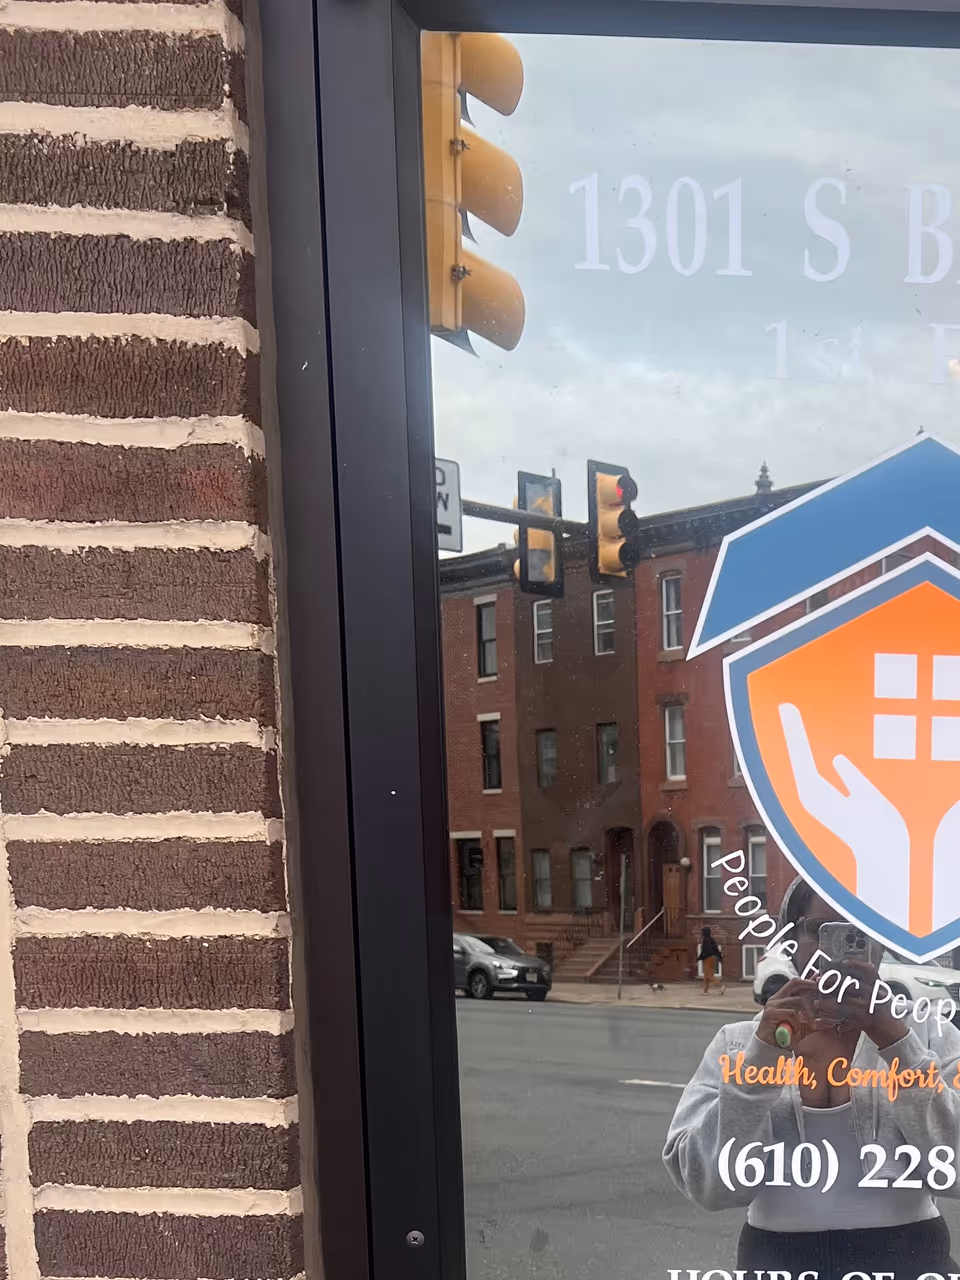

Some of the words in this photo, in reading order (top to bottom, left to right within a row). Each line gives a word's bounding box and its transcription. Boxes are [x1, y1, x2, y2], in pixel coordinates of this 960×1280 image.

[568, 172, 753, 277] 1301
[803, 177, 850, 282] S
[764, 319, 864, 383] 1st
[711, 849, 798, 961] People
[800, 949, 860, 1004] For
[718, 1052, 818, 1090] Health,
[827, 1058, 945, 1102] Comfort,
[717, 1136, 839, 1194] (610)
